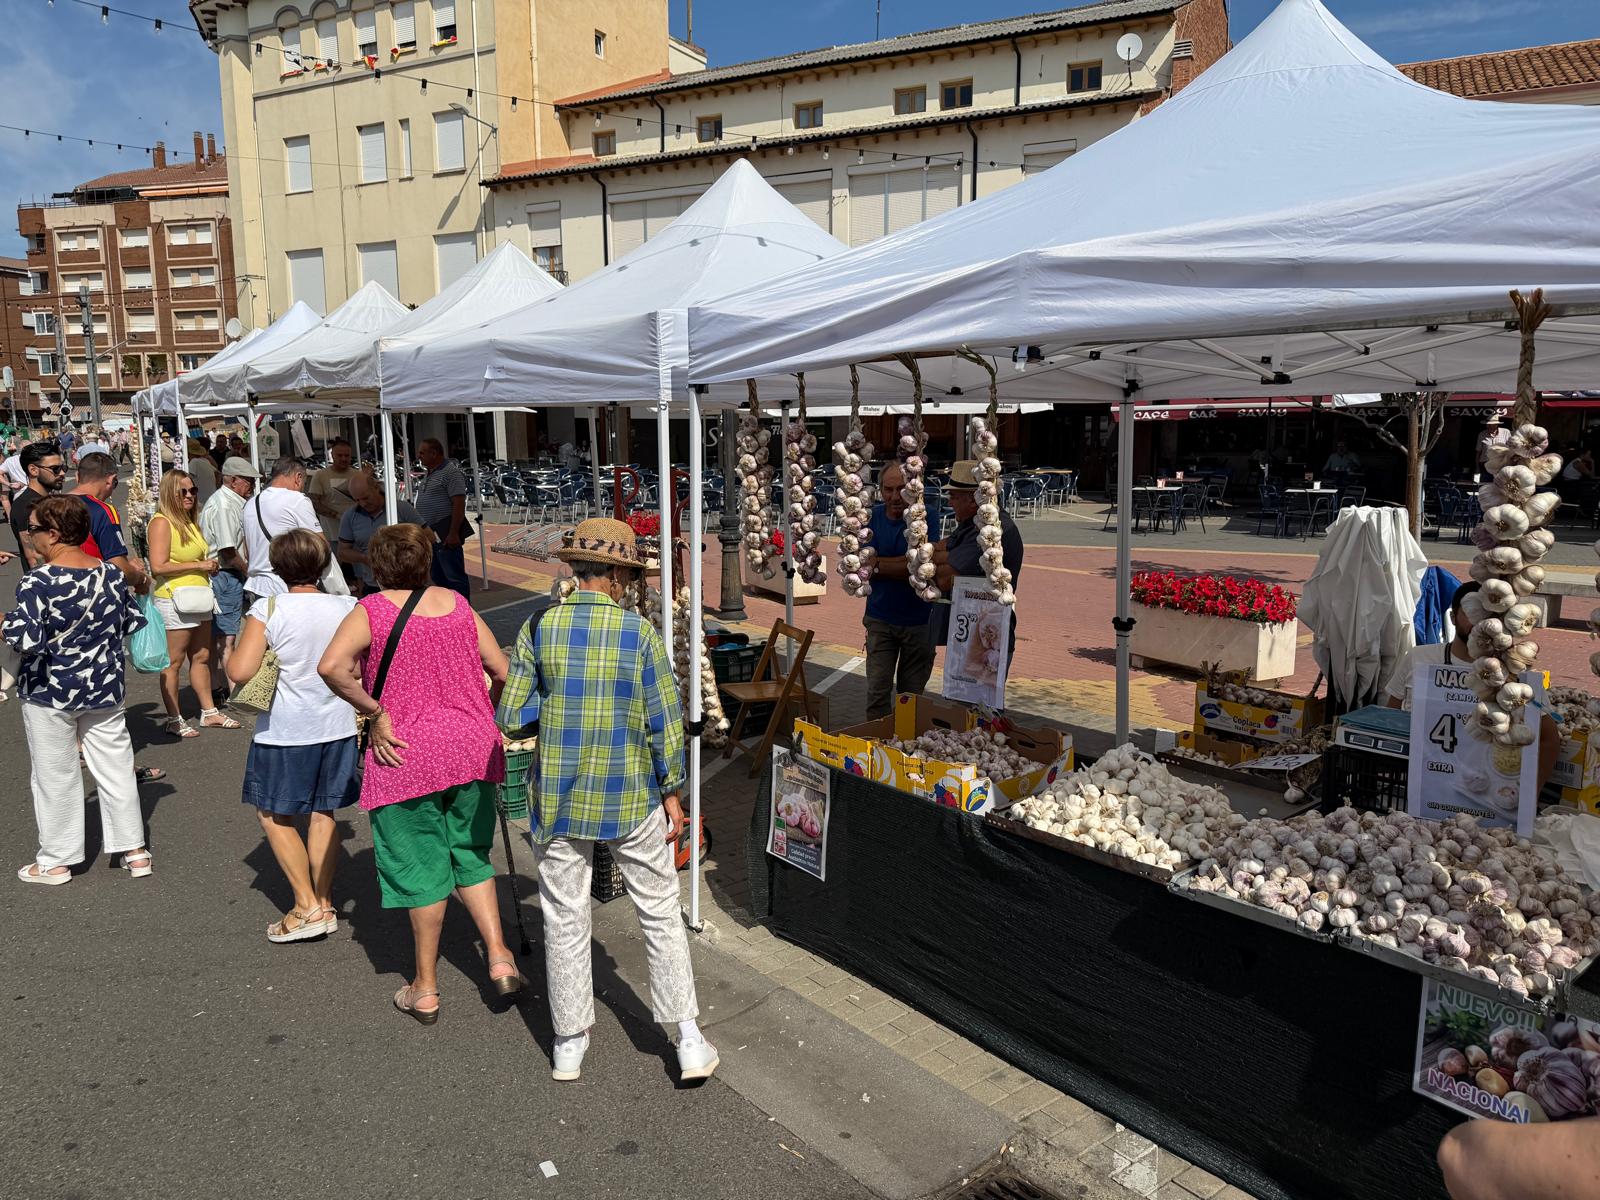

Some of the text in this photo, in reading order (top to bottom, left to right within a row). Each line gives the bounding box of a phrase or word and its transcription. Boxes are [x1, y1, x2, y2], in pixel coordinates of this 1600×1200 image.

[1189, 409, 1218, 419] BAR
[1427, 760, 1454, 773] EXTRA
[1436, 982, 1536, 1033] NUEVO!!
